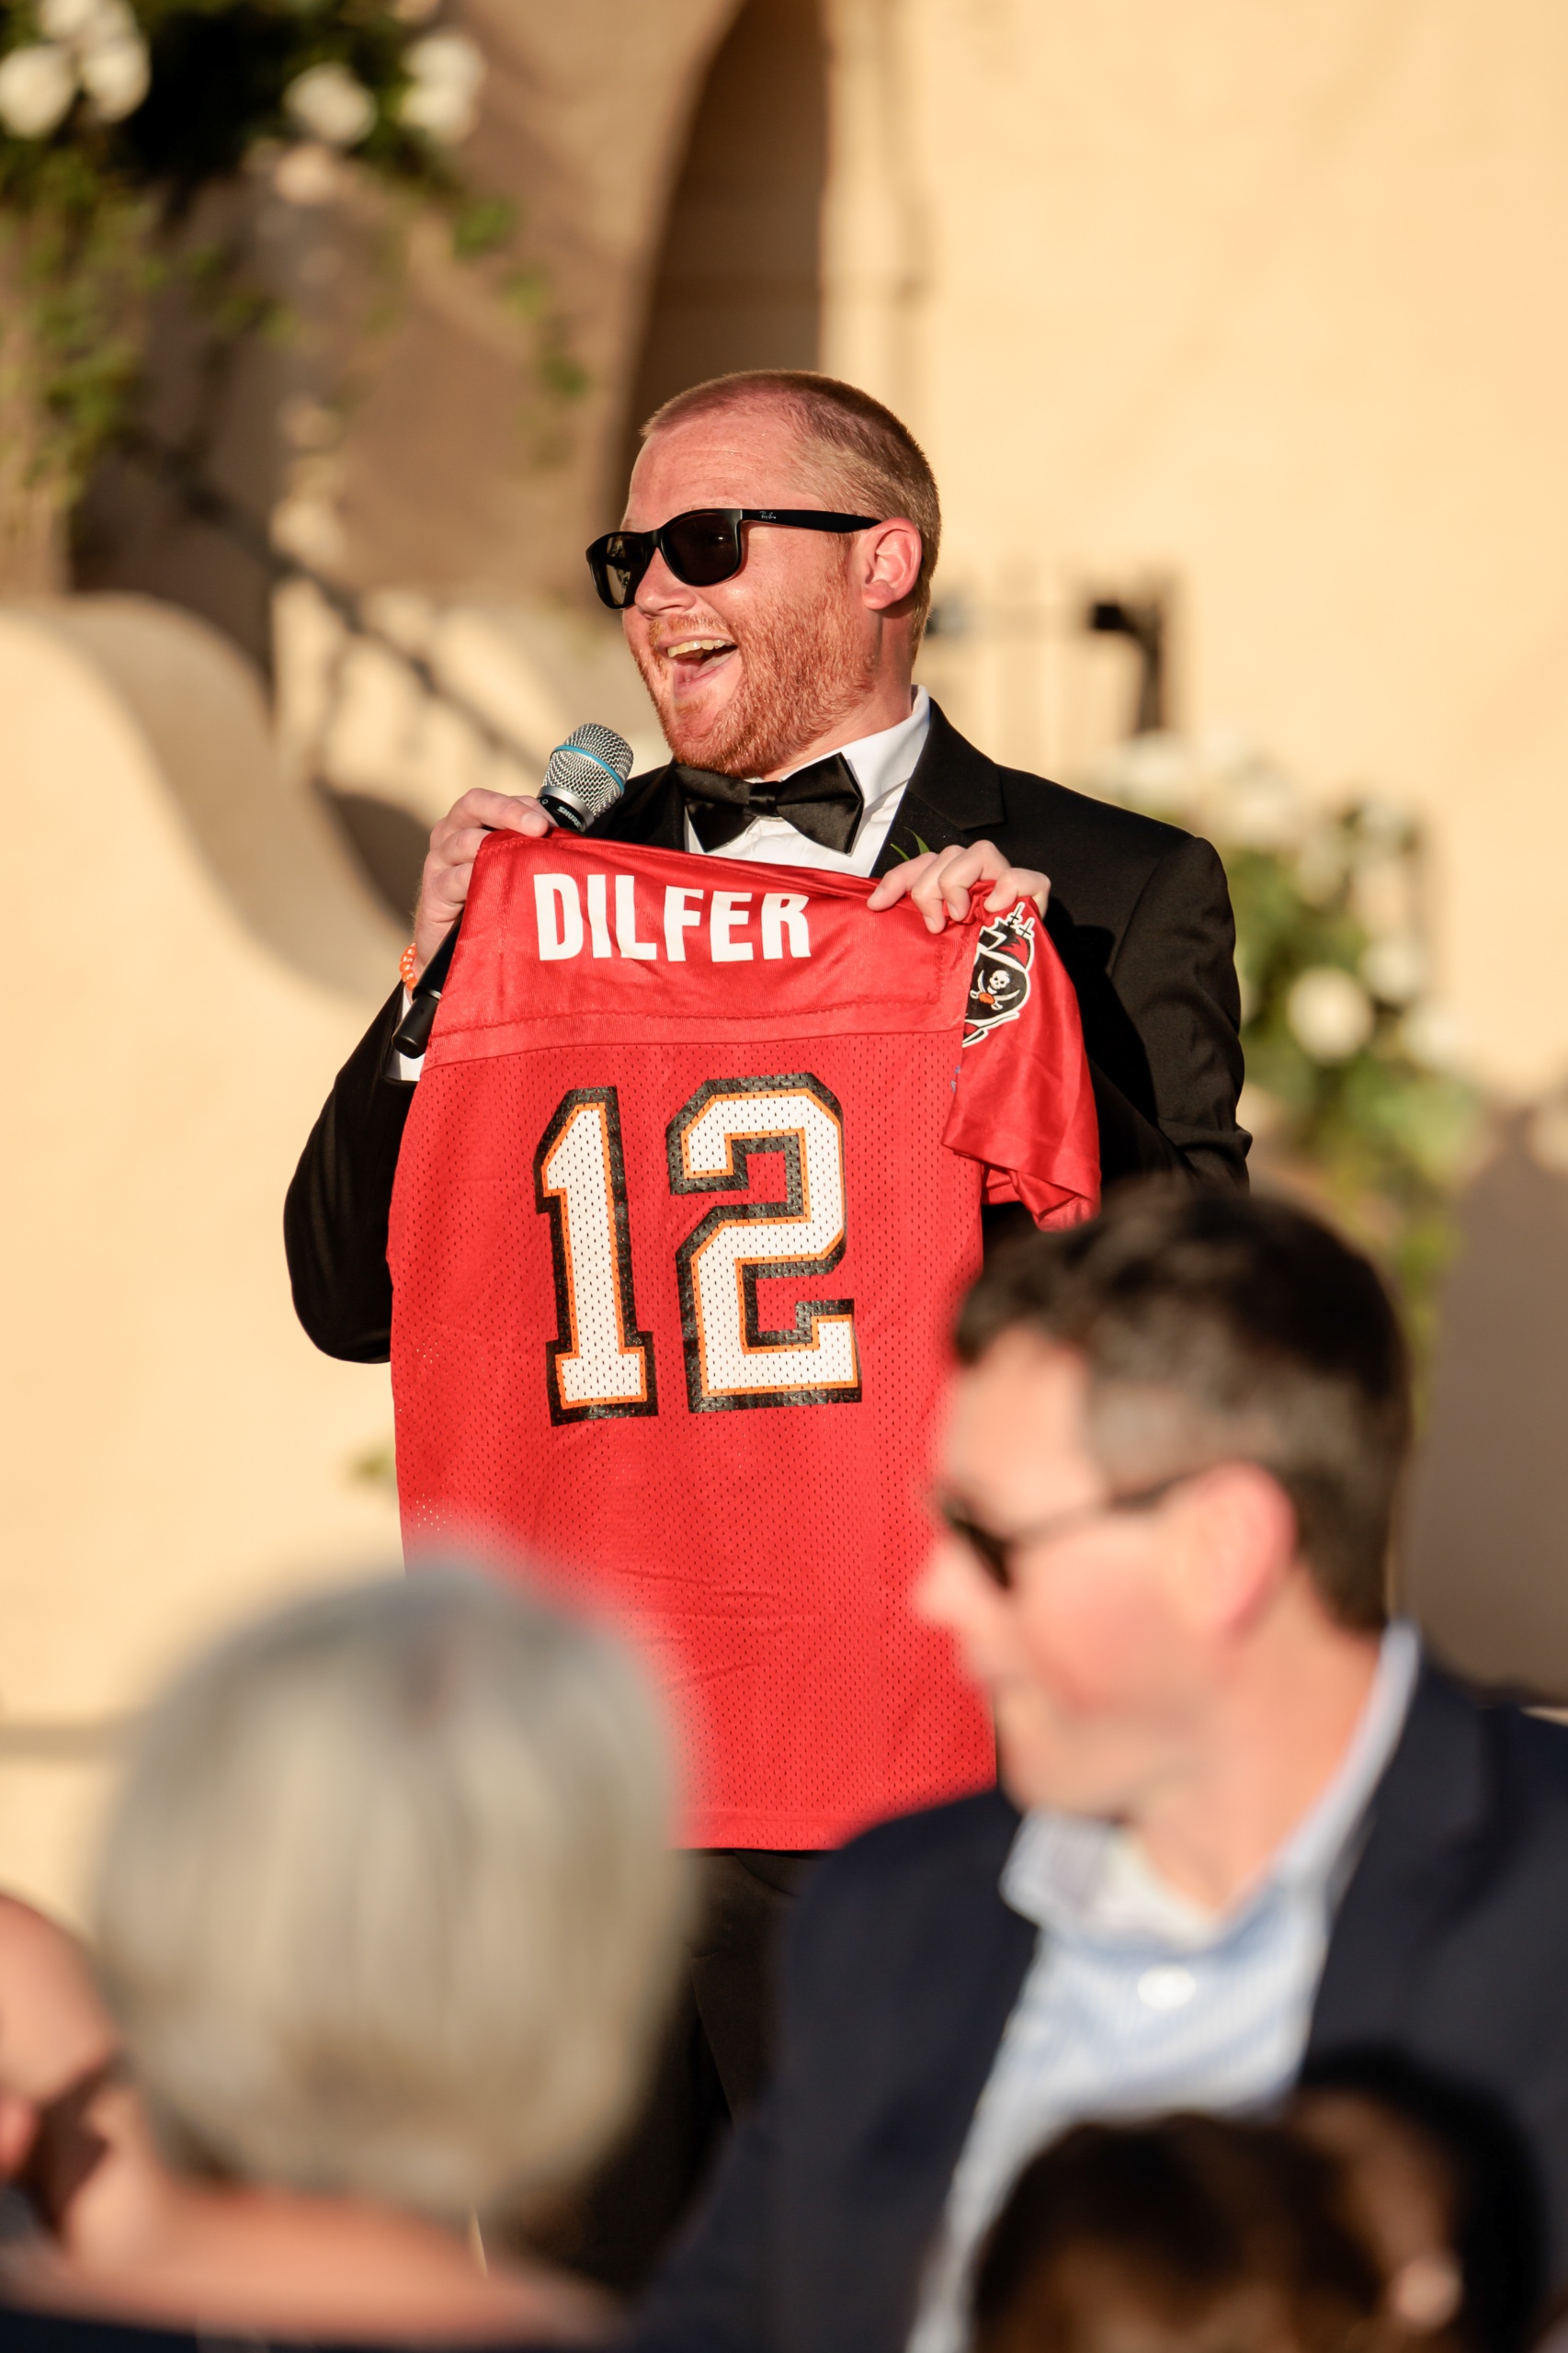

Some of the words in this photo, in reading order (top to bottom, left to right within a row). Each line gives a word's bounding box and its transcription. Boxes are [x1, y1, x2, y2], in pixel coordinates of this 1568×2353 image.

[557, 805, 583, 828] SHURE
[533, 873, 811, 962] DILFER
[533, 1073, 862, 1427] 12
